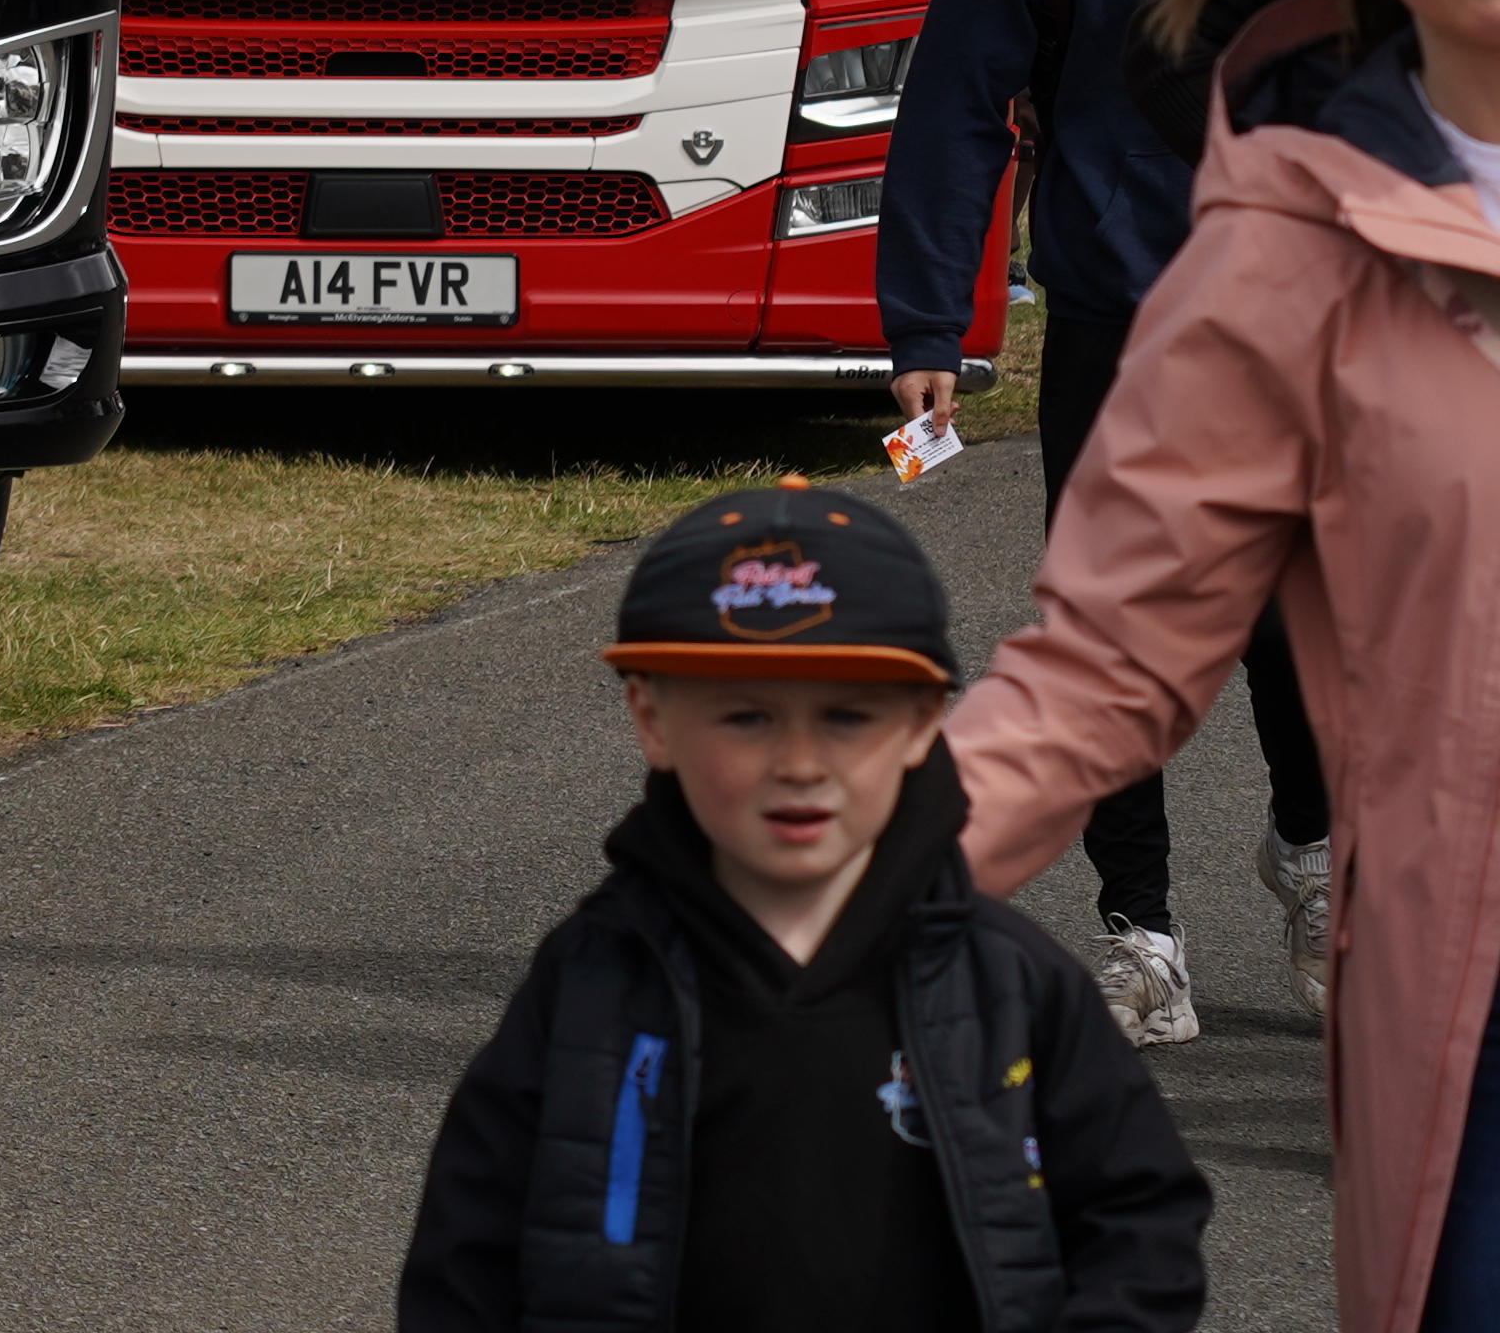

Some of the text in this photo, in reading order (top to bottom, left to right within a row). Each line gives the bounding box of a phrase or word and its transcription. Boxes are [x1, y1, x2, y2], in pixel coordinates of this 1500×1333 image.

[279, 260, 469, 307] A14 FVR
[834, 365, 887, 380] LoBar
